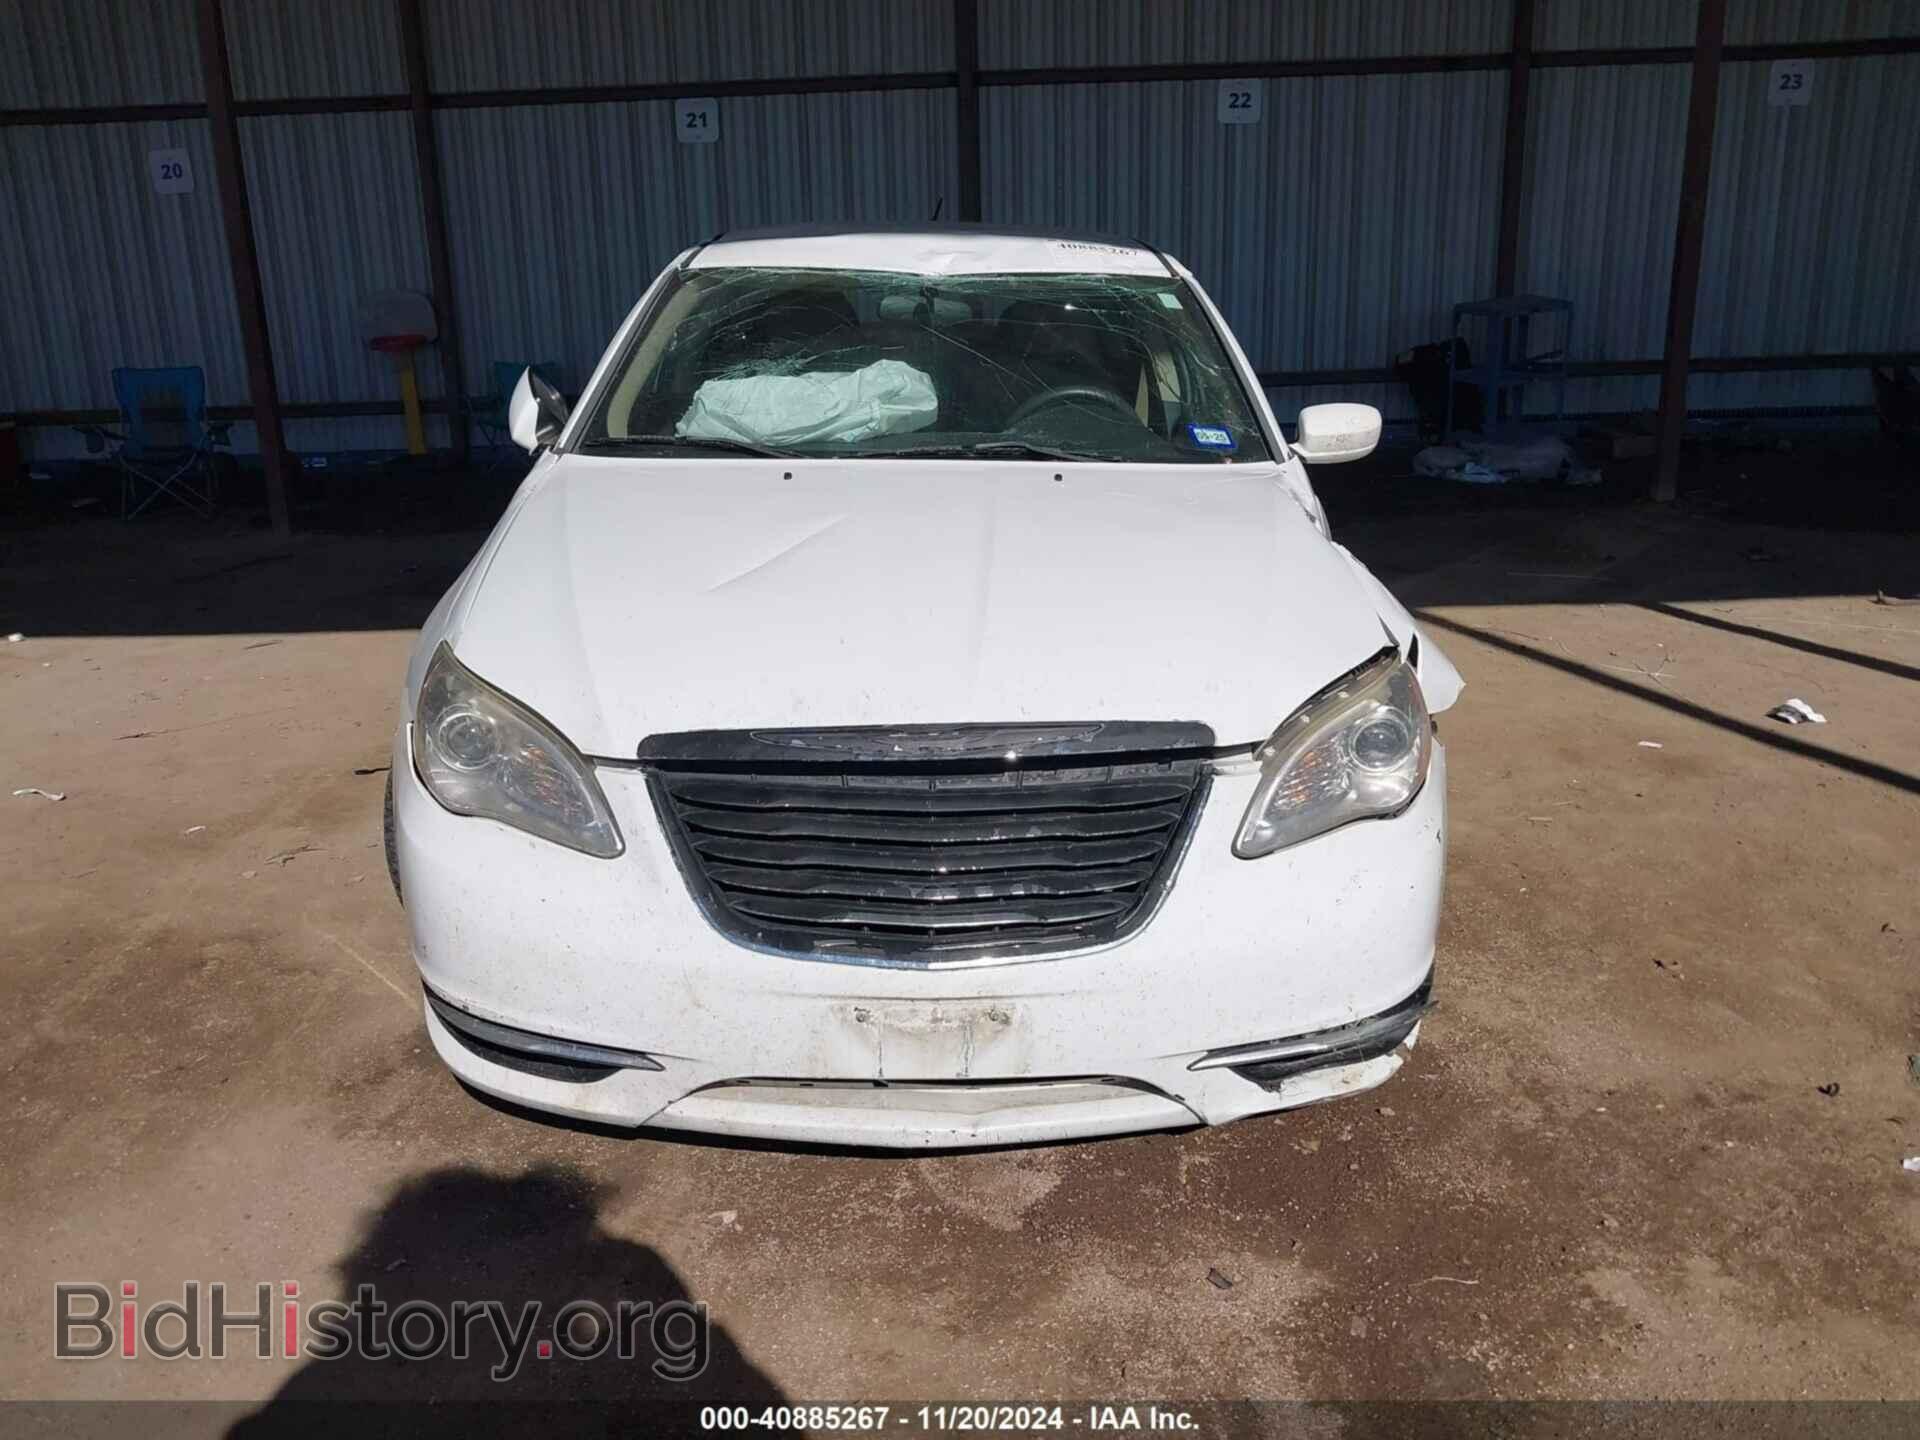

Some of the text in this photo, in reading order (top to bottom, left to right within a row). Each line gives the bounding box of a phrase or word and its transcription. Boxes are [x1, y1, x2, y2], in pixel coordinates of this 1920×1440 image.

[1779, 73, 1803, 90] 23
[1228, 92, 1252, 109] 22
[685, 111, 707, 128] 21
[160, 163, 183, 180] 20
